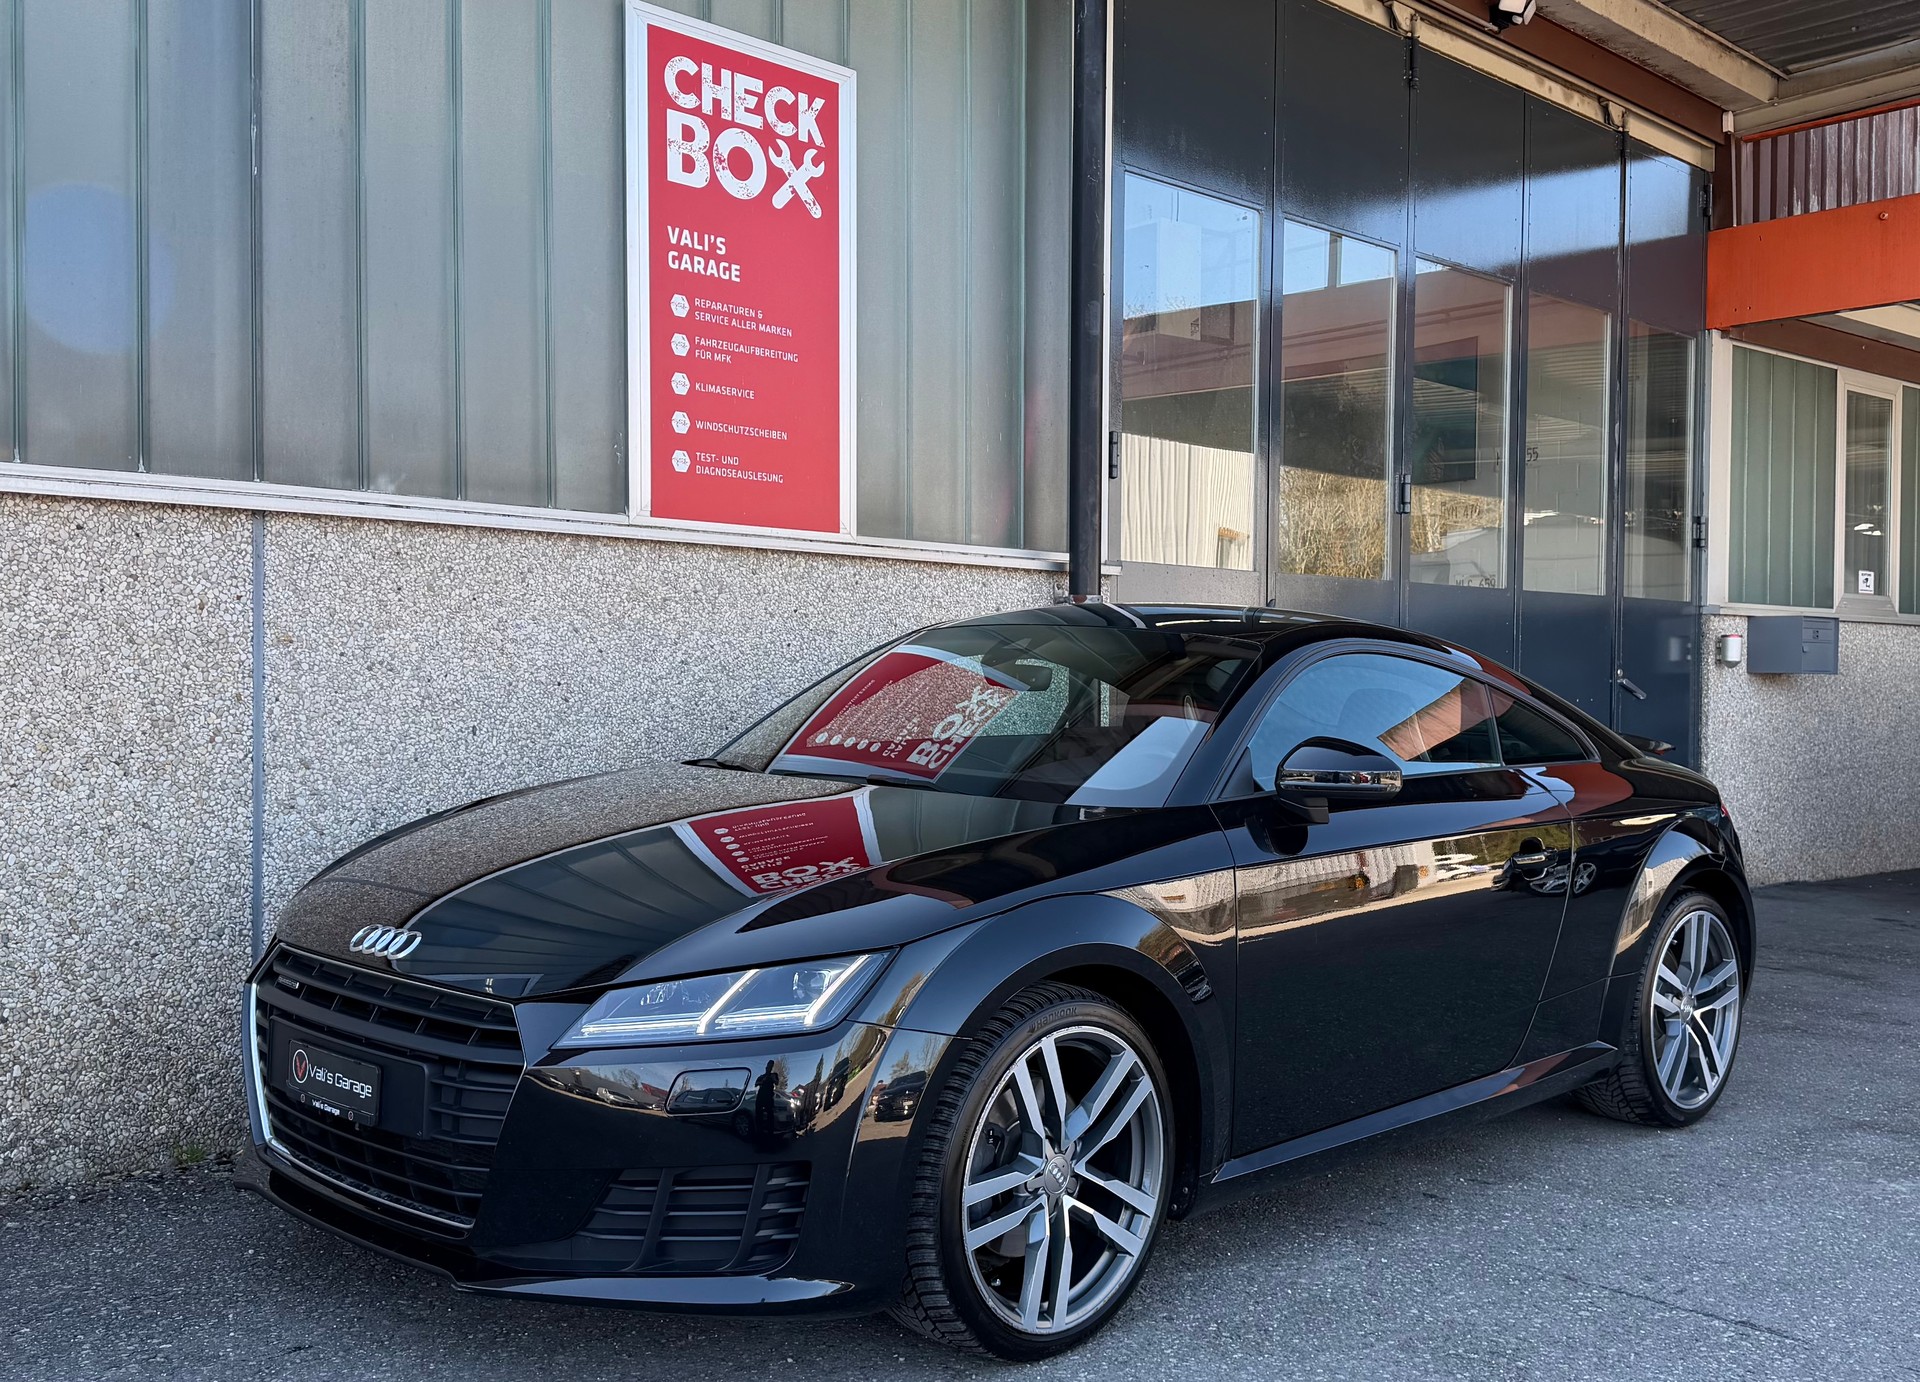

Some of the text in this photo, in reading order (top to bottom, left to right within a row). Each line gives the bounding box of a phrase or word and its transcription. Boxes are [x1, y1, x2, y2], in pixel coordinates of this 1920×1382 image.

[664, 55, 826, 148] CHECK
[666, 108, 826, 219] BOX
[667, 225, 727, 255] VALI'S
[667, 251, 741, 282] GARAGE
[694, 297, 763, 319] REPARATUREN &
[694, 311, 793, 337] SERVICE ALLER MARKEN
[695, 336, 799, 363] FAHRZEUGAUFBEREITUNG
[695, 348, 732, 364] FÜR MFK
[695, 382, 755, 399] KLIMASERVICE
[695, 420, 788, 440] WINDSCHUTZSCHEIBEN
[695, 452, 739, 465] TEST- UND
[695, 465, 784, 483] DIAGNOSEAUSLESUNG
[309, 1063, 334, 1085] Vali's
[334, 1073, 373, 1099] Garage
